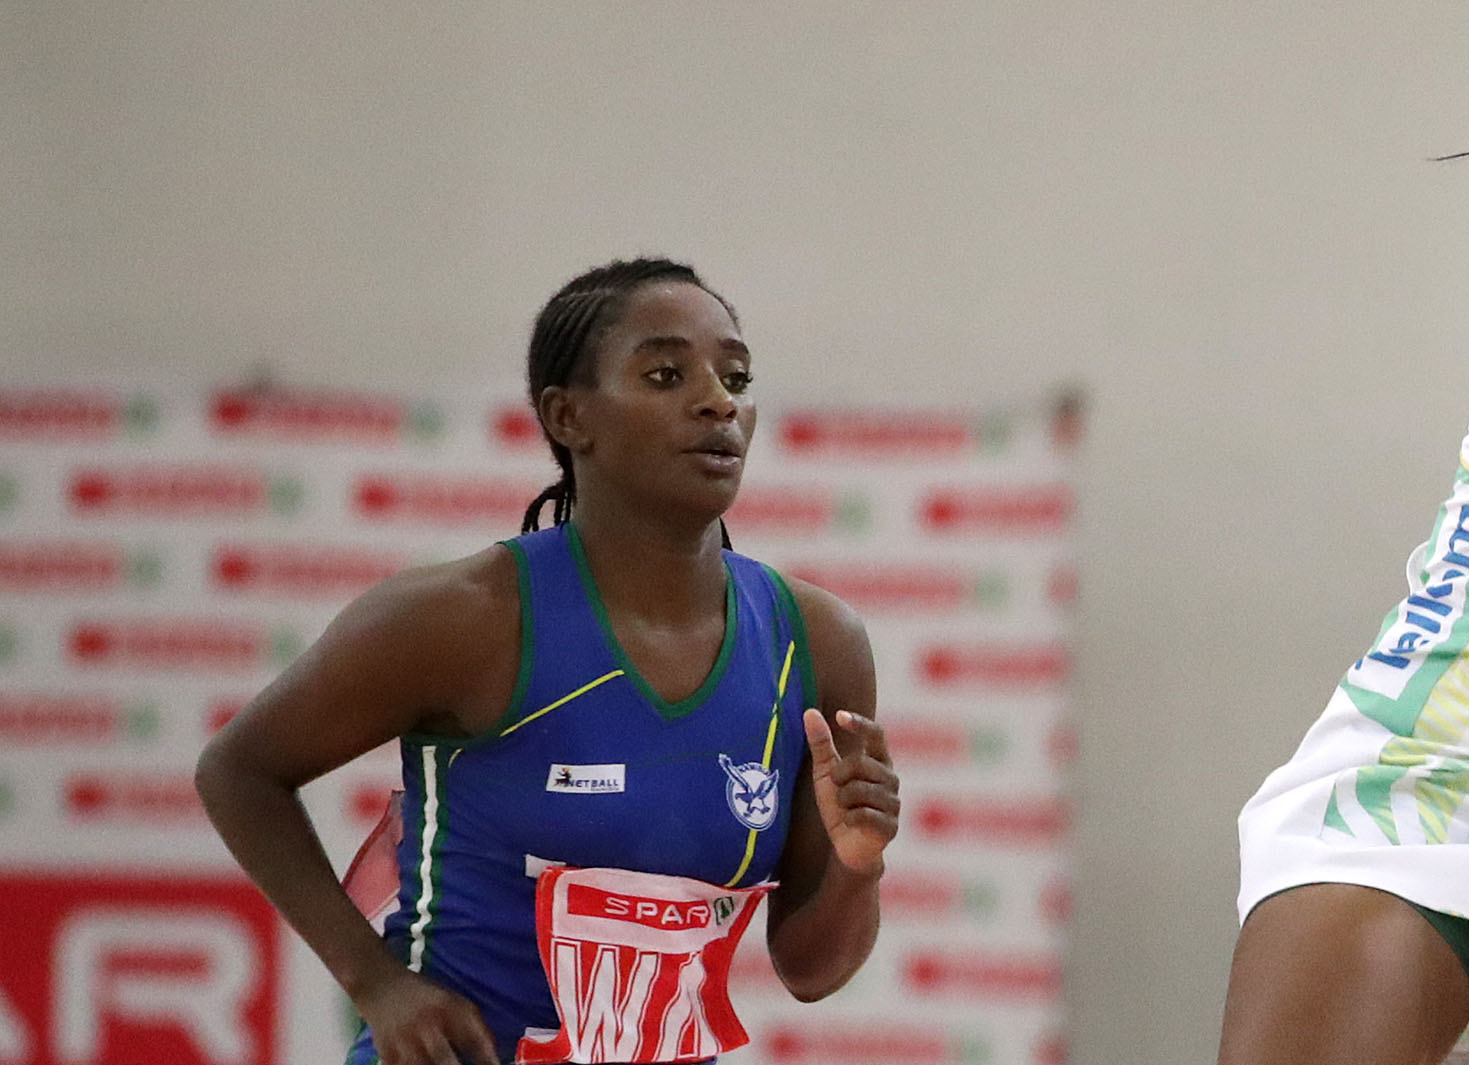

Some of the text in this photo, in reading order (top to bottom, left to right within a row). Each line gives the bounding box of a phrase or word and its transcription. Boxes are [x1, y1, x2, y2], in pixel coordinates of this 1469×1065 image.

[564, 779, 620, 788] NETBALL
[603, 896, 709, 926] SPAR
[551, 938, 722, 1064] WA
